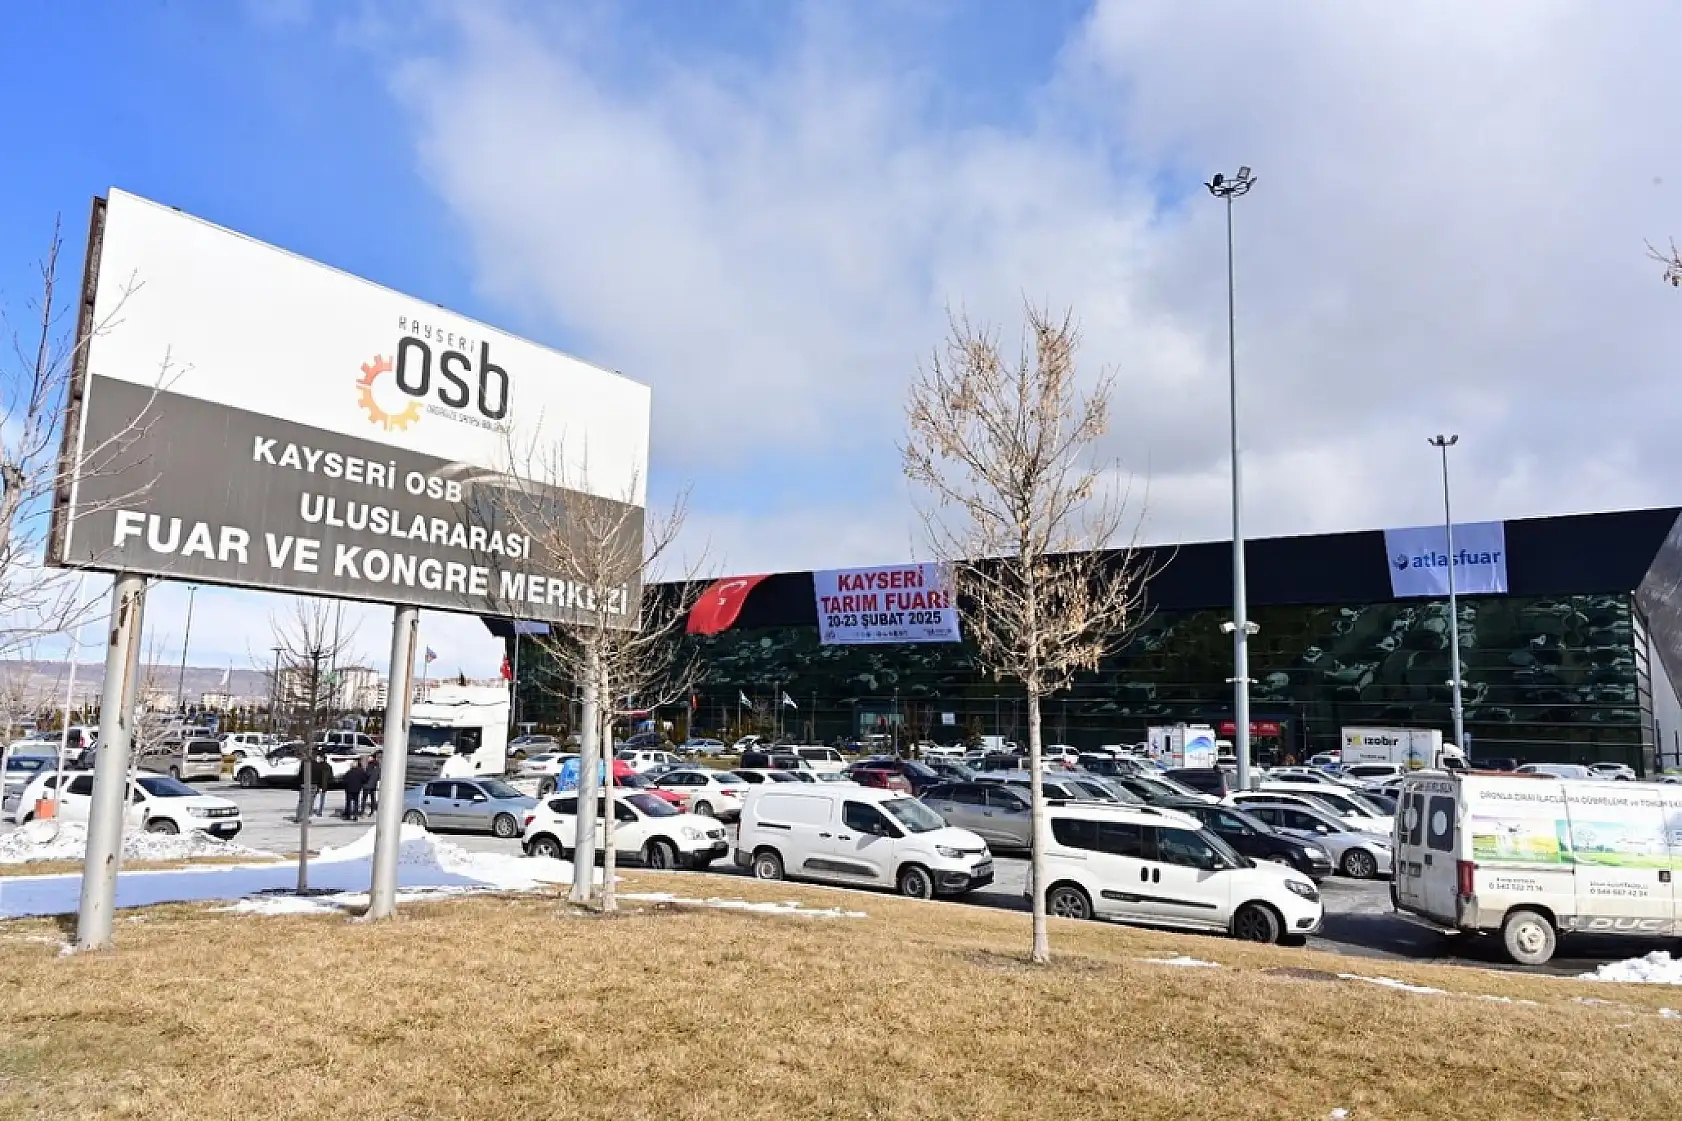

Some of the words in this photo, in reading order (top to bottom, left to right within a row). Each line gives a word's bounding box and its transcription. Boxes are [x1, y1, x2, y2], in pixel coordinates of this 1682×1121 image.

[253, 435, 397, 490] KAYSERİ
[405, 471, 462, 503] OSB
[300, 492, 531, 560] ULUSLARARASI
[113, 509, 251, 564] FUAR
[264, 532, 321, 573] VE
[334, 543, 490, 596] KONGRE
[1412, 549, 1501, 568] atlasfuar
[838, 565, 923, 592] KAYSERİ
[820, 593, 879, 613] TARIM
[827, 614, 858, 627] 20-23
[861, 612, 904, 629] ŞUBAT
[909, 610, 942, 625] 2025
